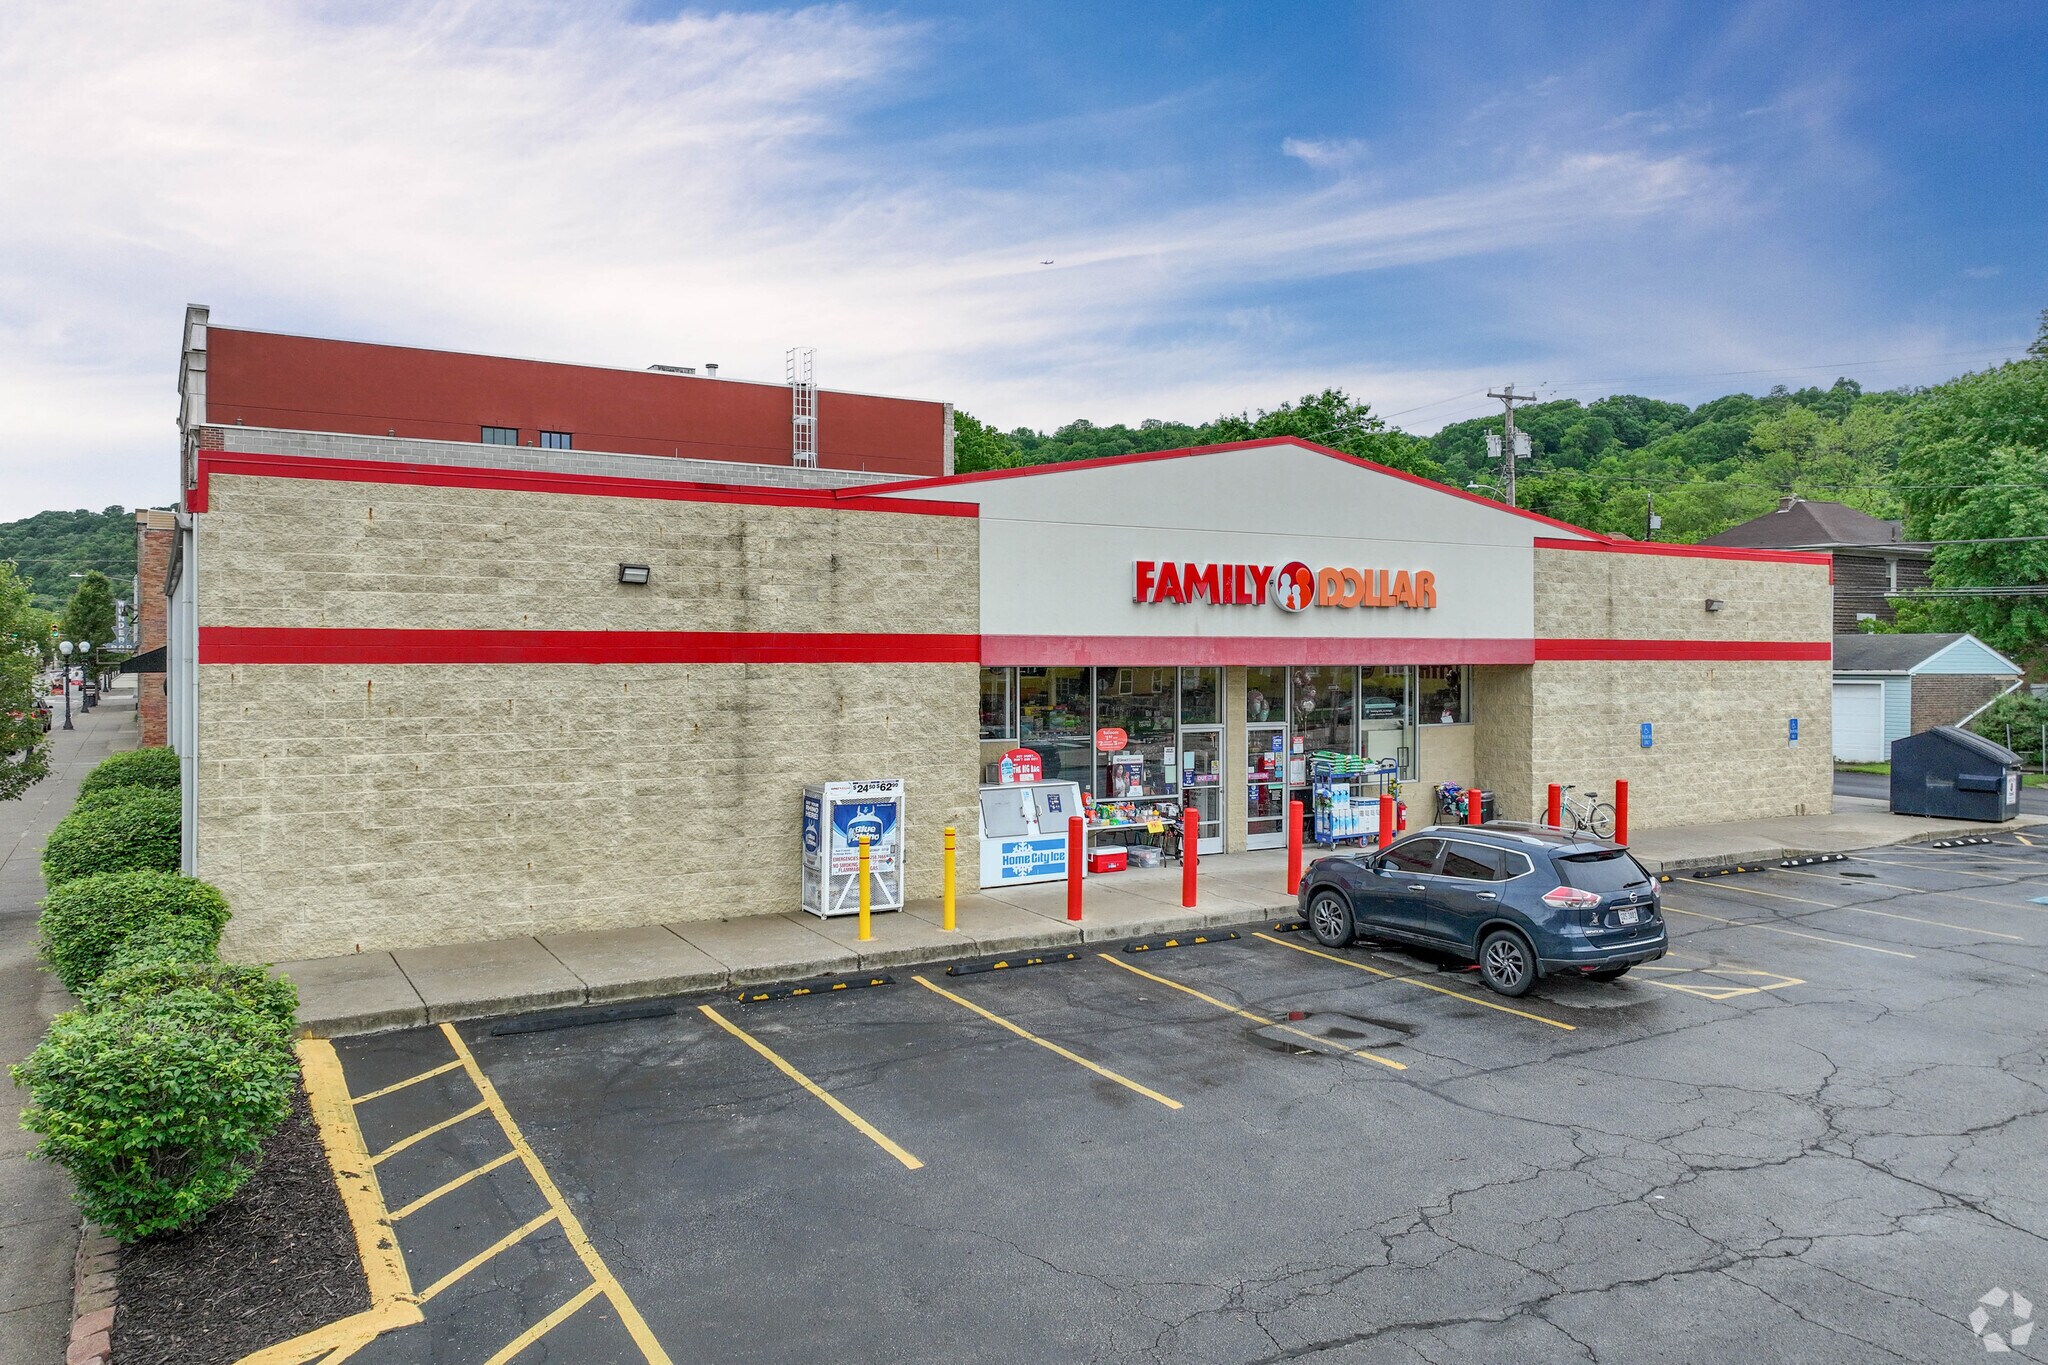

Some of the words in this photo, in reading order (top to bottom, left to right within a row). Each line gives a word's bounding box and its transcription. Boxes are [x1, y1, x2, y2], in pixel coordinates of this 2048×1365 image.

[1133, 560, 1275, 606] FAMILY
[1315, 566, 1437, 609] DOLLAR
[1013, 765, 1021, 774] THE
[1022, 764, 1030, 773] BIG
[1031, 764, 1040, 772] BAG
[855, 825, 876, 834] Blue
[1002, 855, 1030, 866] Home
[1031, 852, 1049, 864] City
[1050, 851, 1065, 861] Ice
